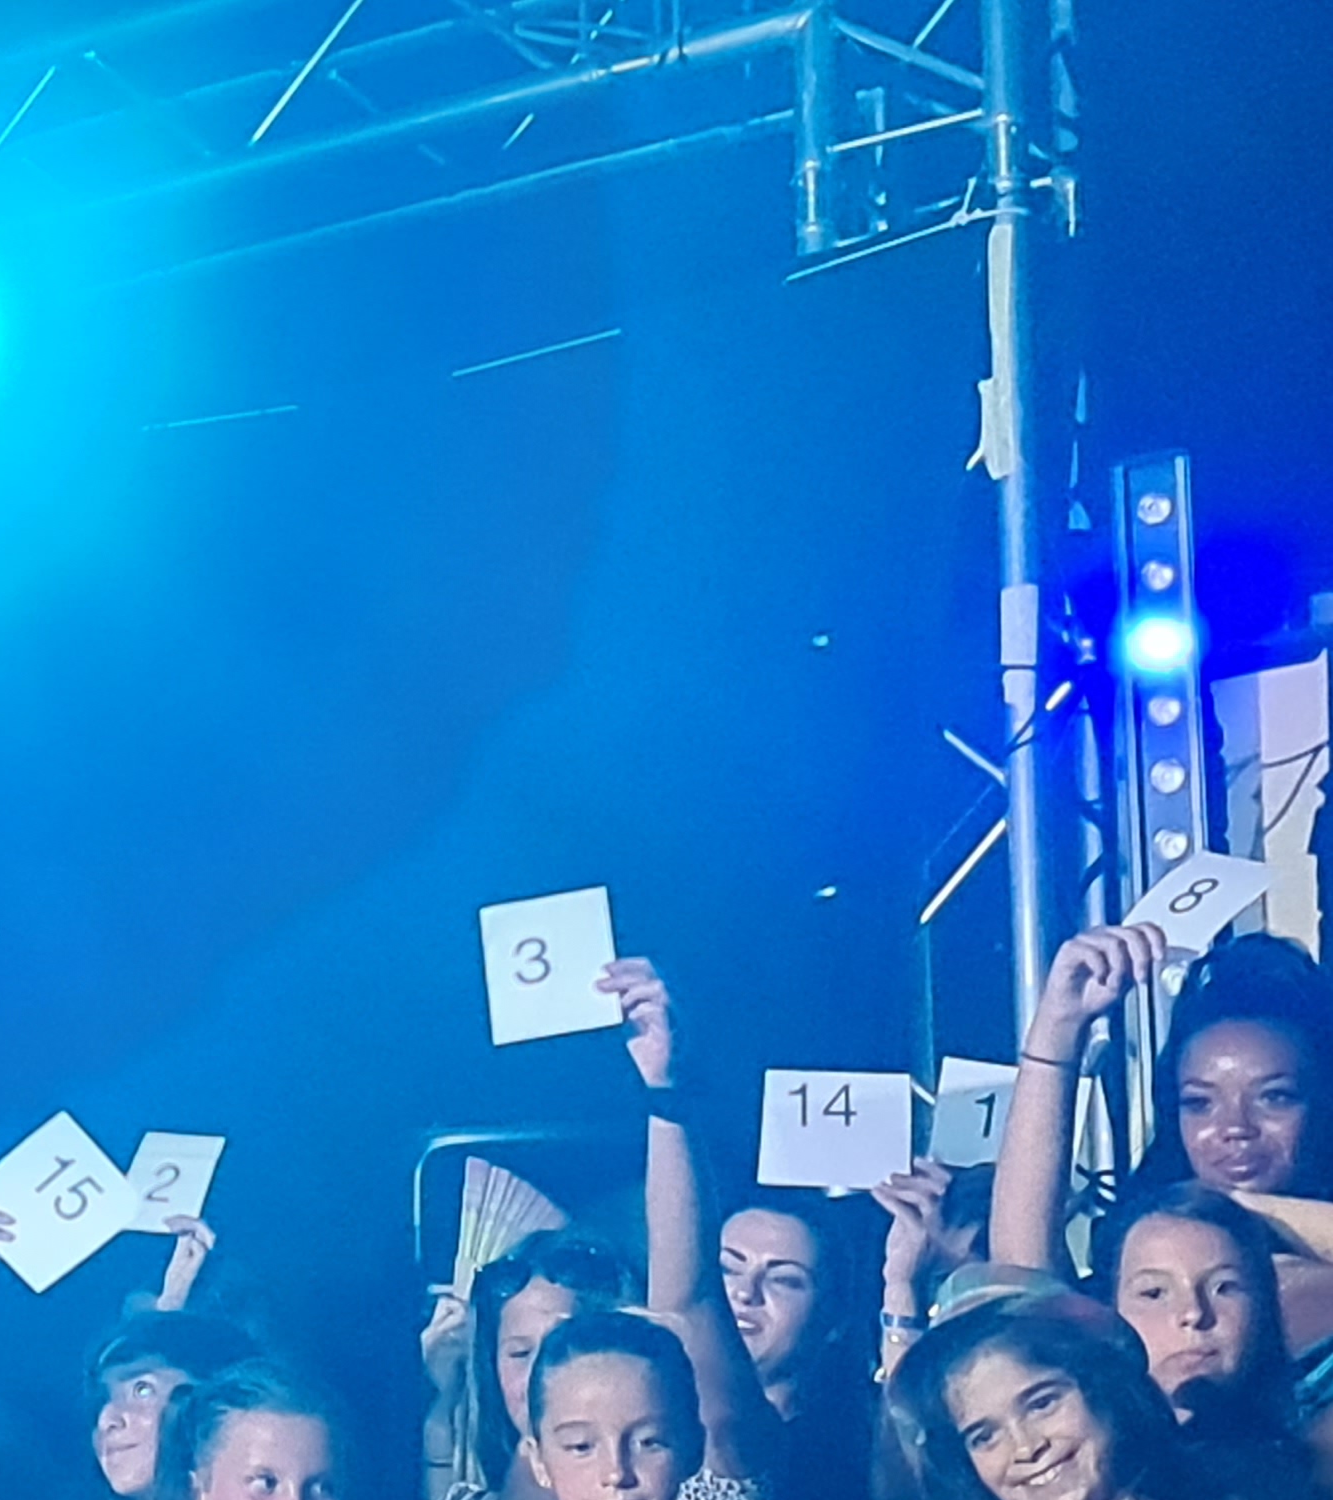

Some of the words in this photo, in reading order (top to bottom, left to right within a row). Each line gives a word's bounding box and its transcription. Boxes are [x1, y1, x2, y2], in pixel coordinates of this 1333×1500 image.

[1168, 877, 1219, 914] 8
[512, 938, 551, 985] 3
[788, 1083, 857, 1127] 14
[34, 1155, 104, 1220] 15
[145, 1162, 180, 1202] 2
